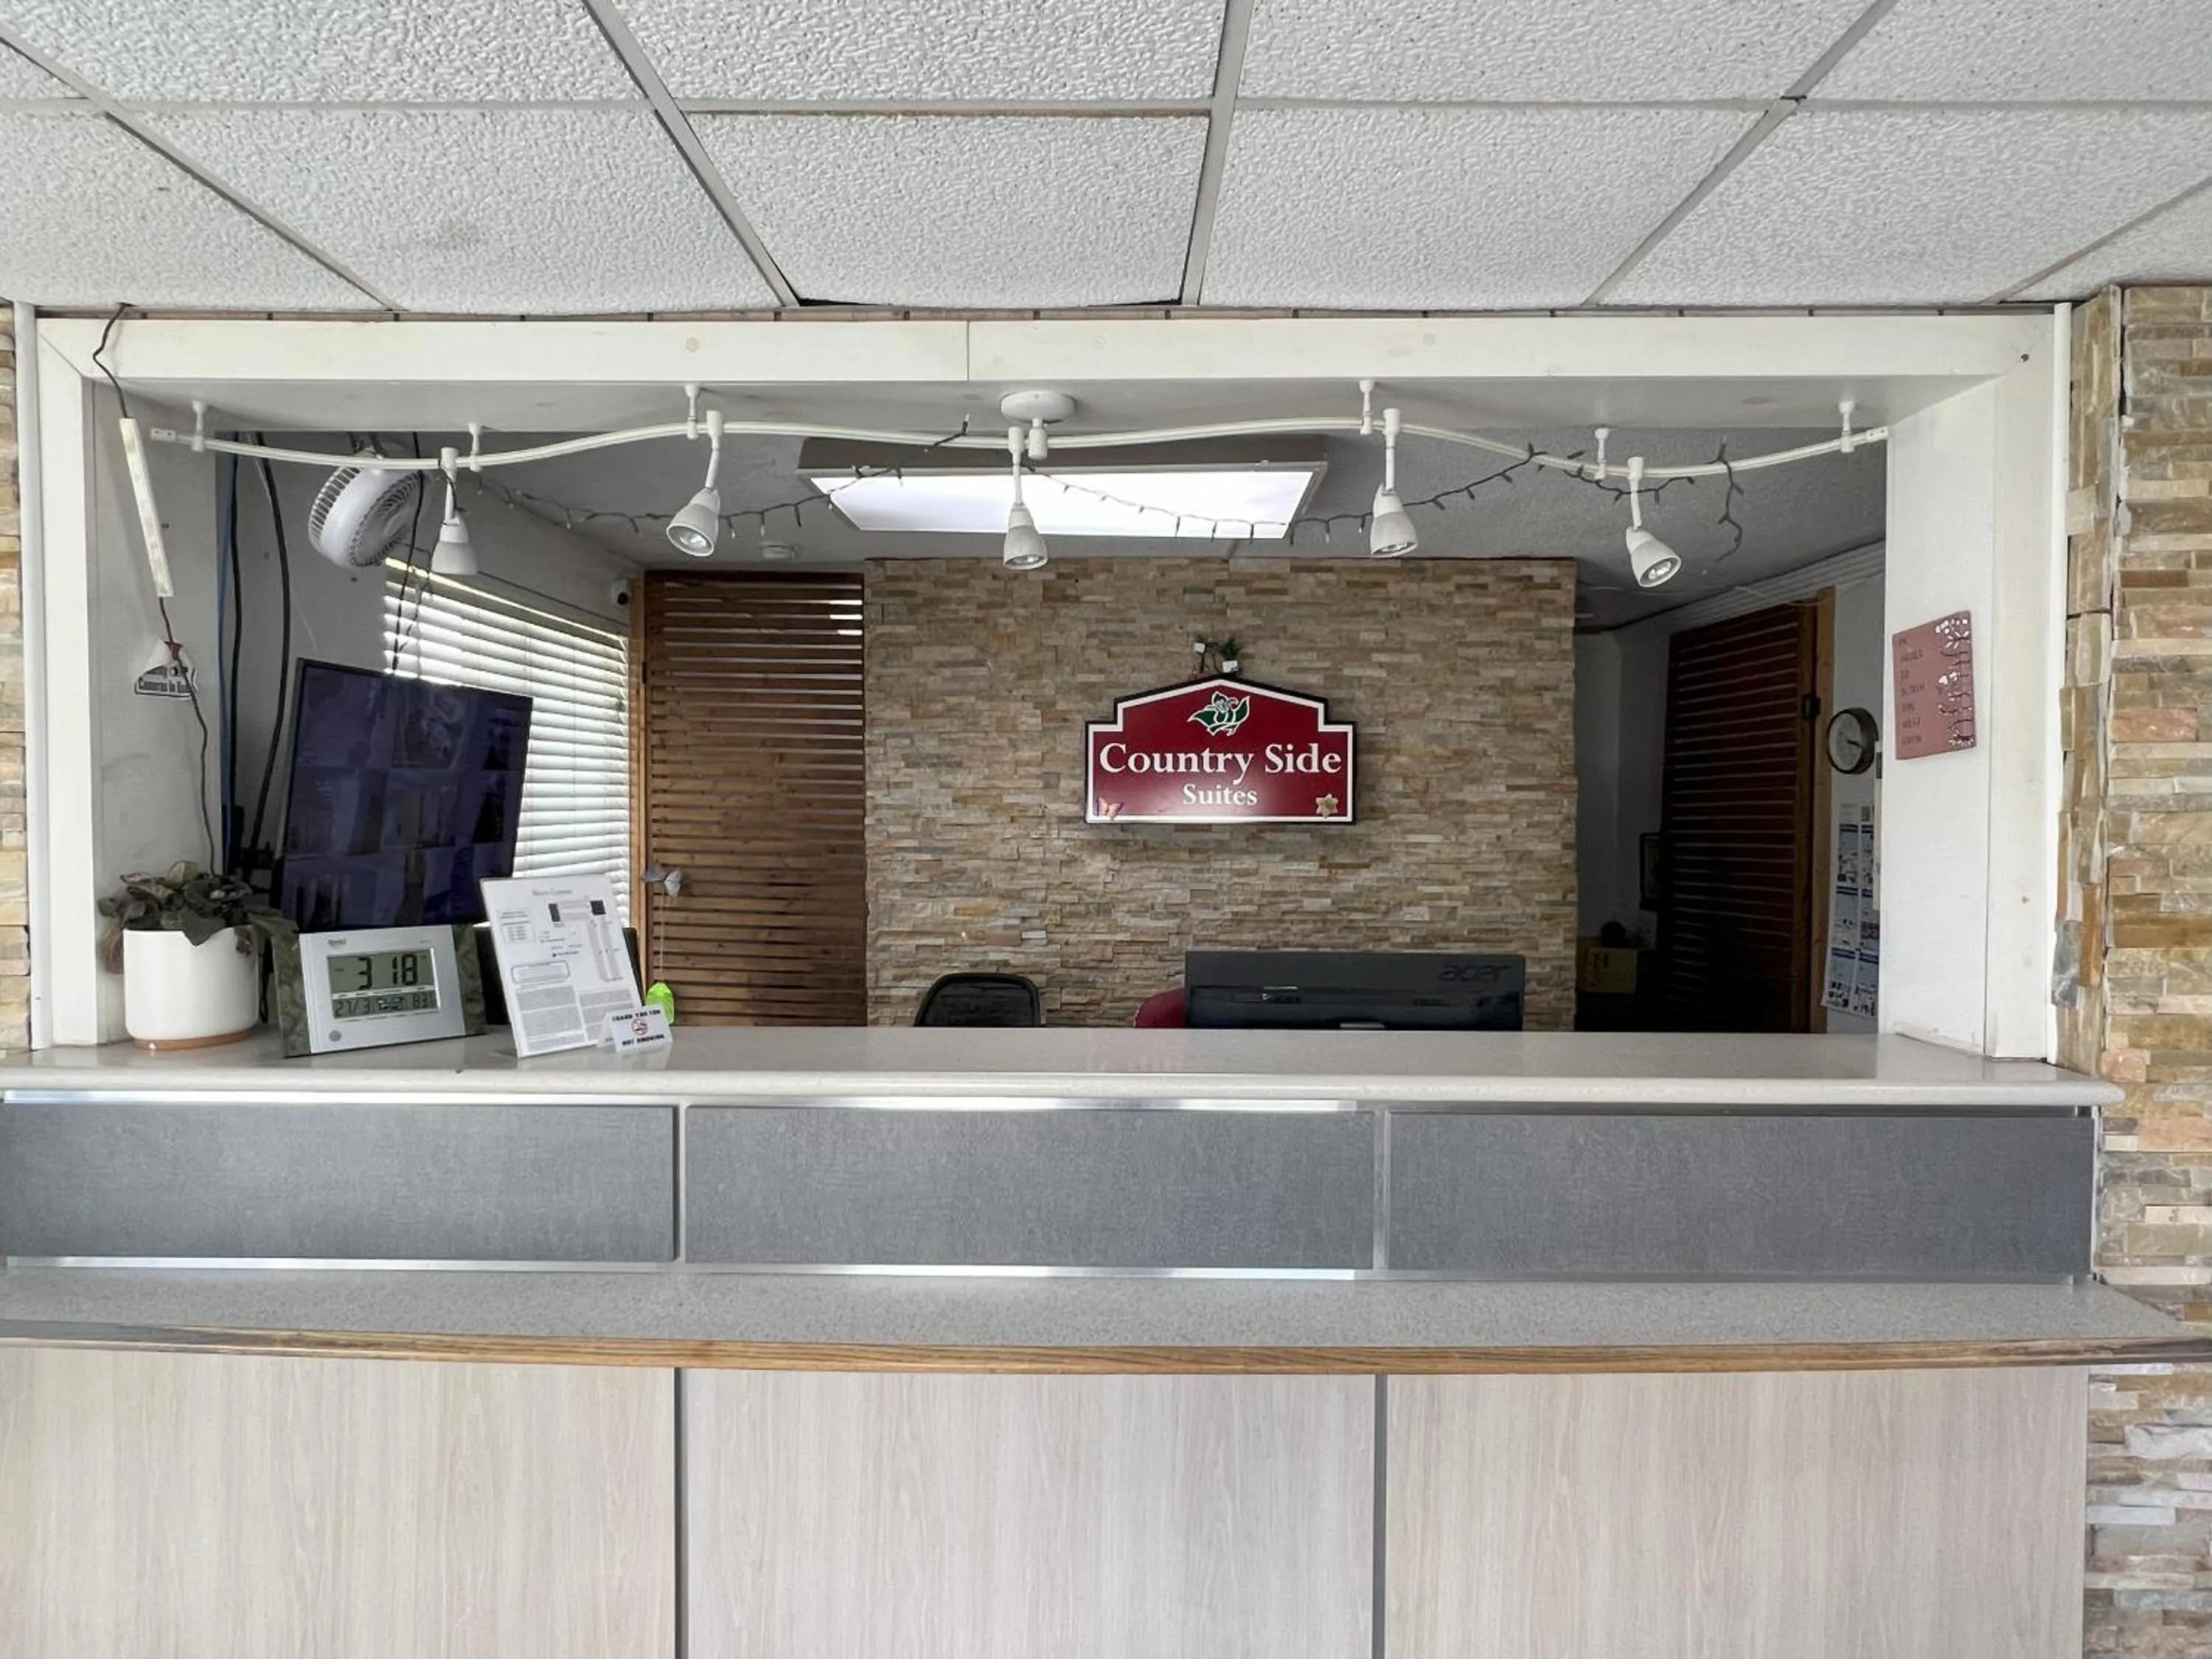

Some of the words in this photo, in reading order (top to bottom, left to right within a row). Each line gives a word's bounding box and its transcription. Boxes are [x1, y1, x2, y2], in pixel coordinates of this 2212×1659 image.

[1099, 742, 1254, 785] Country
[1265, 742, 1342, 773] Side
[1183, 784, 1257, 805] Suites
[1438, 964, 1511, 983] acer
